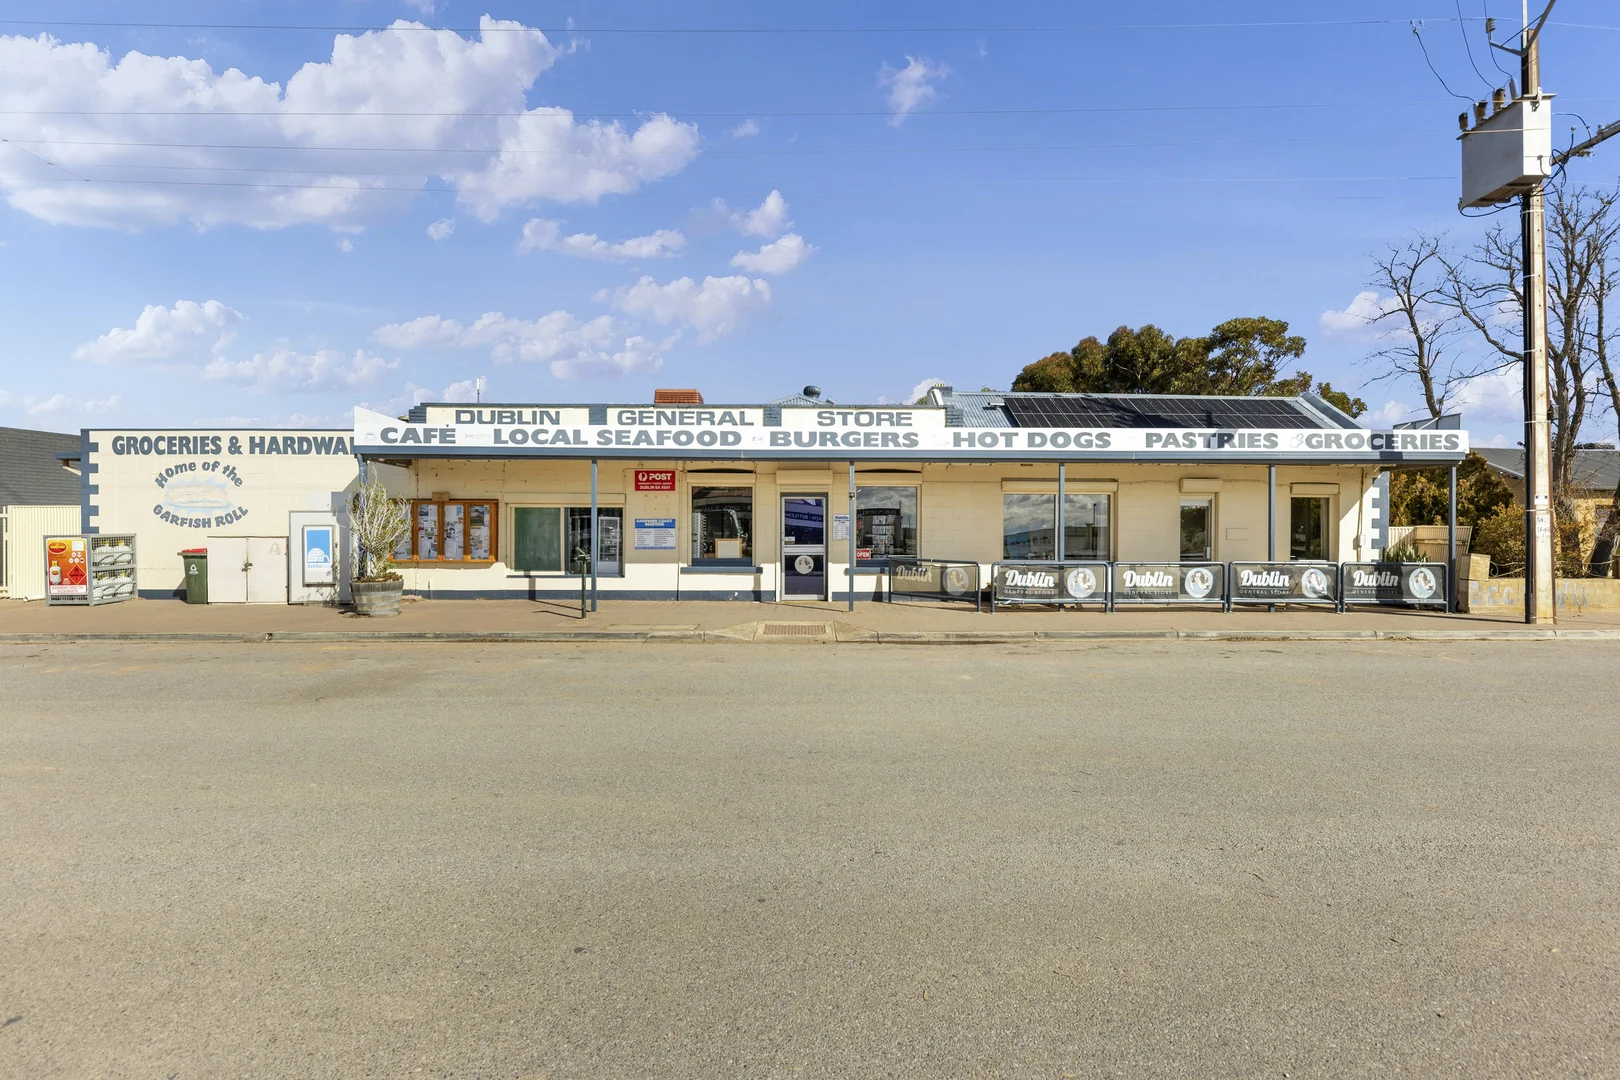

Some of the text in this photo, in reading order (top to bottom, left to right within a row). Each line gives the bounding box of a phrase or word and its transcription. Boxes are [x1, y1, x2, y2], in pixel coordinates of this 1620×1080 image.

[455, 409, 913, 427] DUBLIN GENERAL STORE
[111, 436, 222, 455] GROCERIES
[228, 436, 243, 455] &
[493, 429, 589, 445] LOCAL
[596, 429, 742, 447] SEAFOOD
[769, 431, 919, 448] BURGERS
[952, 431, 1018, 448] HOT
[1027, 432, 1112, 448] DOGS
[1145, 432, 1279, 449] PASTRIES
[1305, 432, 1460, 450] GROCERIES
[155, 460, 243, 489] Home of the
[153, 504, 249, 528] GARFISH ROLL
[896, 564, 932, 583] Dublin
[1004, 569, 1055, 588] Dublin
[1122, 570, 1173, 588] Dublin
[1240, 569, 1290, 587] Dublin
[1353, 570, 1399, 587] Dublin
